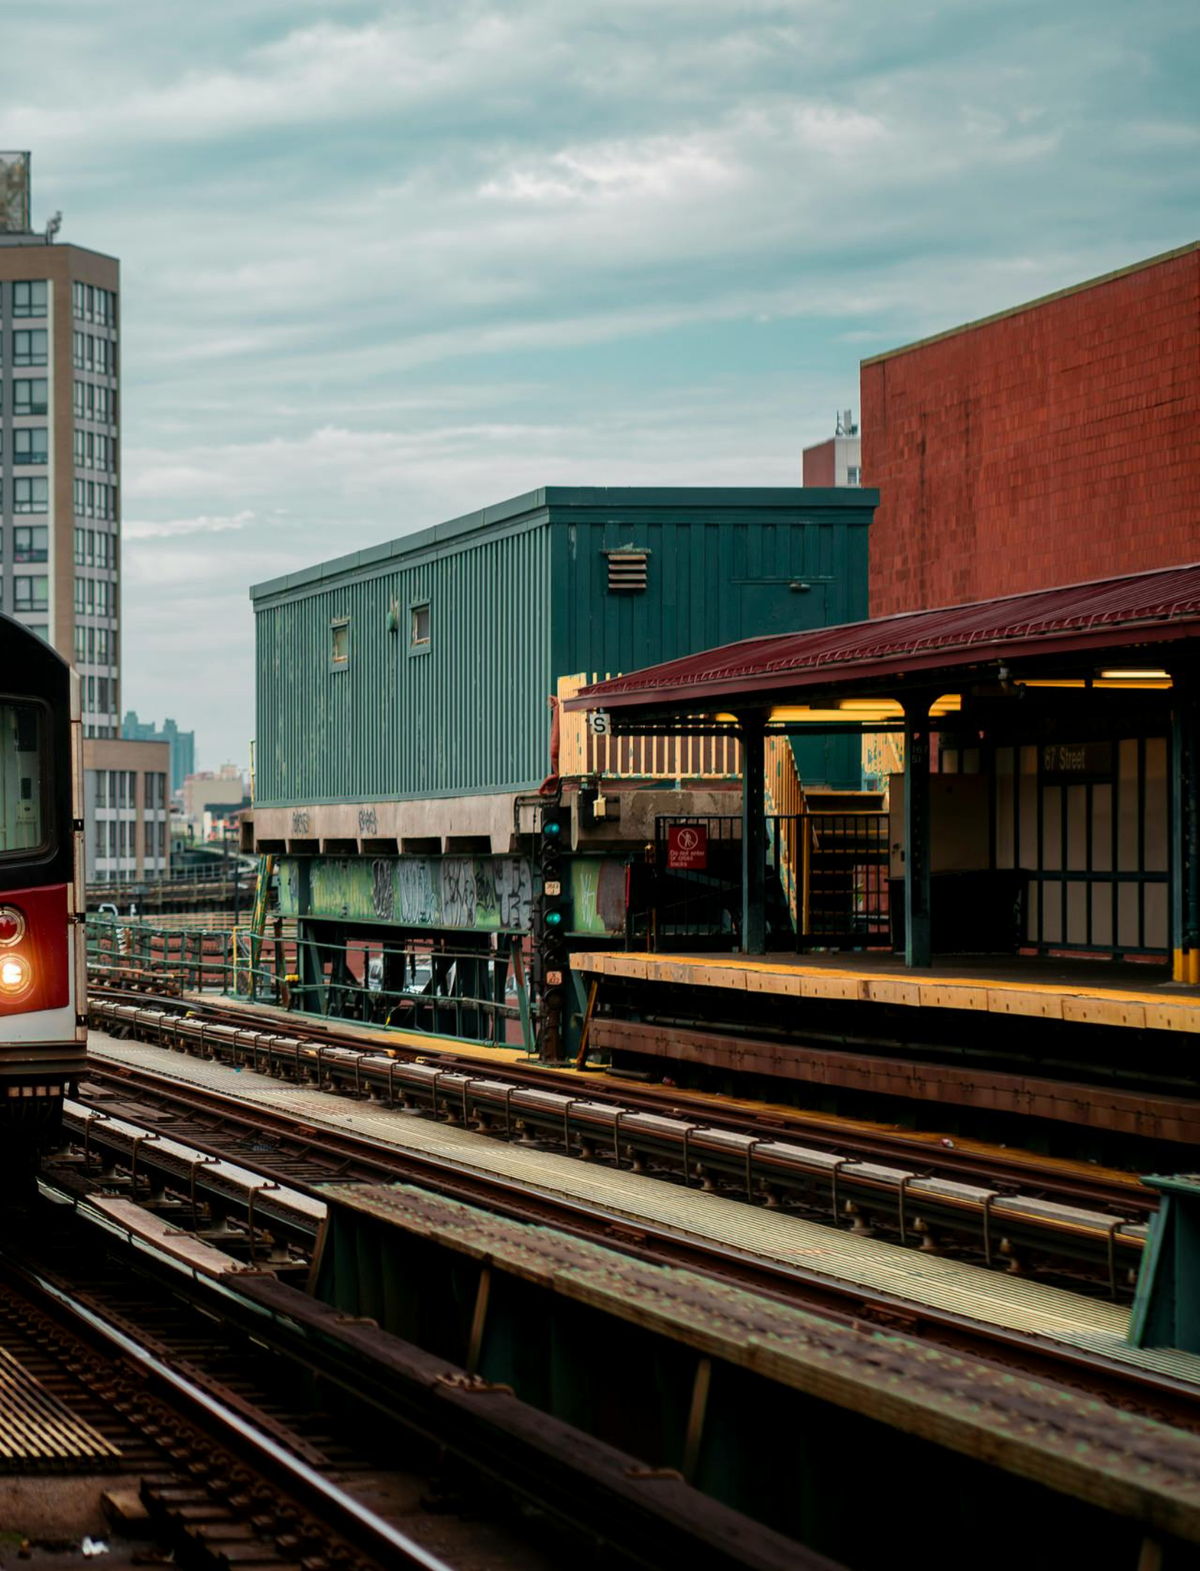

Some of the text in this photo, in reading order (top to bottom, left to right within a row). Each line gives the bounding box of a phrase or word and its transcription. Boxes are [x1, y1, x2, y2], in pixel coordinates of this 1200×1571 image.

[594, 717, 606, 733] S
[1044, 746, 1085, 771] 67 Street
